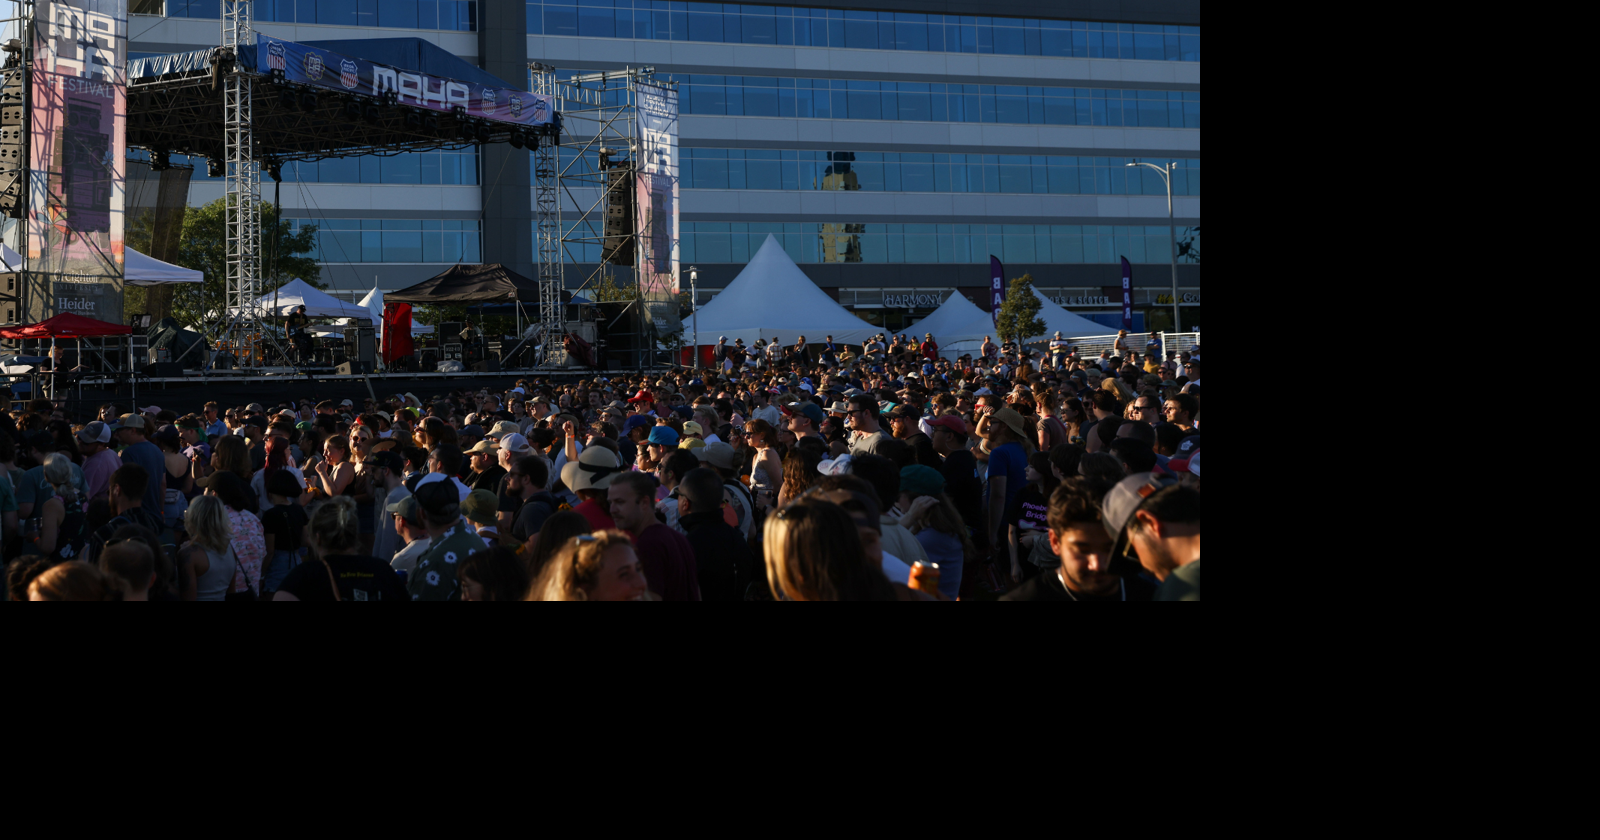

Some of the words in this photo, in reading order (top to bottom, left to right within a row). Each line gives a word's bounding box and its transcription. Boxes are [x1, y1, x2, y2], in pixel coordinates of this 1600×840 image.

[48, 75, 114, 99] FESTIVAL
[372, 65, 470, 113] MAHA
[644, 174, 671, 187] FESTIVAL
[53, 269, 98, 284] Creighton
[58, 297, 95, 310] Heider
[884, 292, 943, 307] HARMONY
[1077, 296, 1109, 304] SCOTCH
[1026, 510, 1048, 521] Bridg
